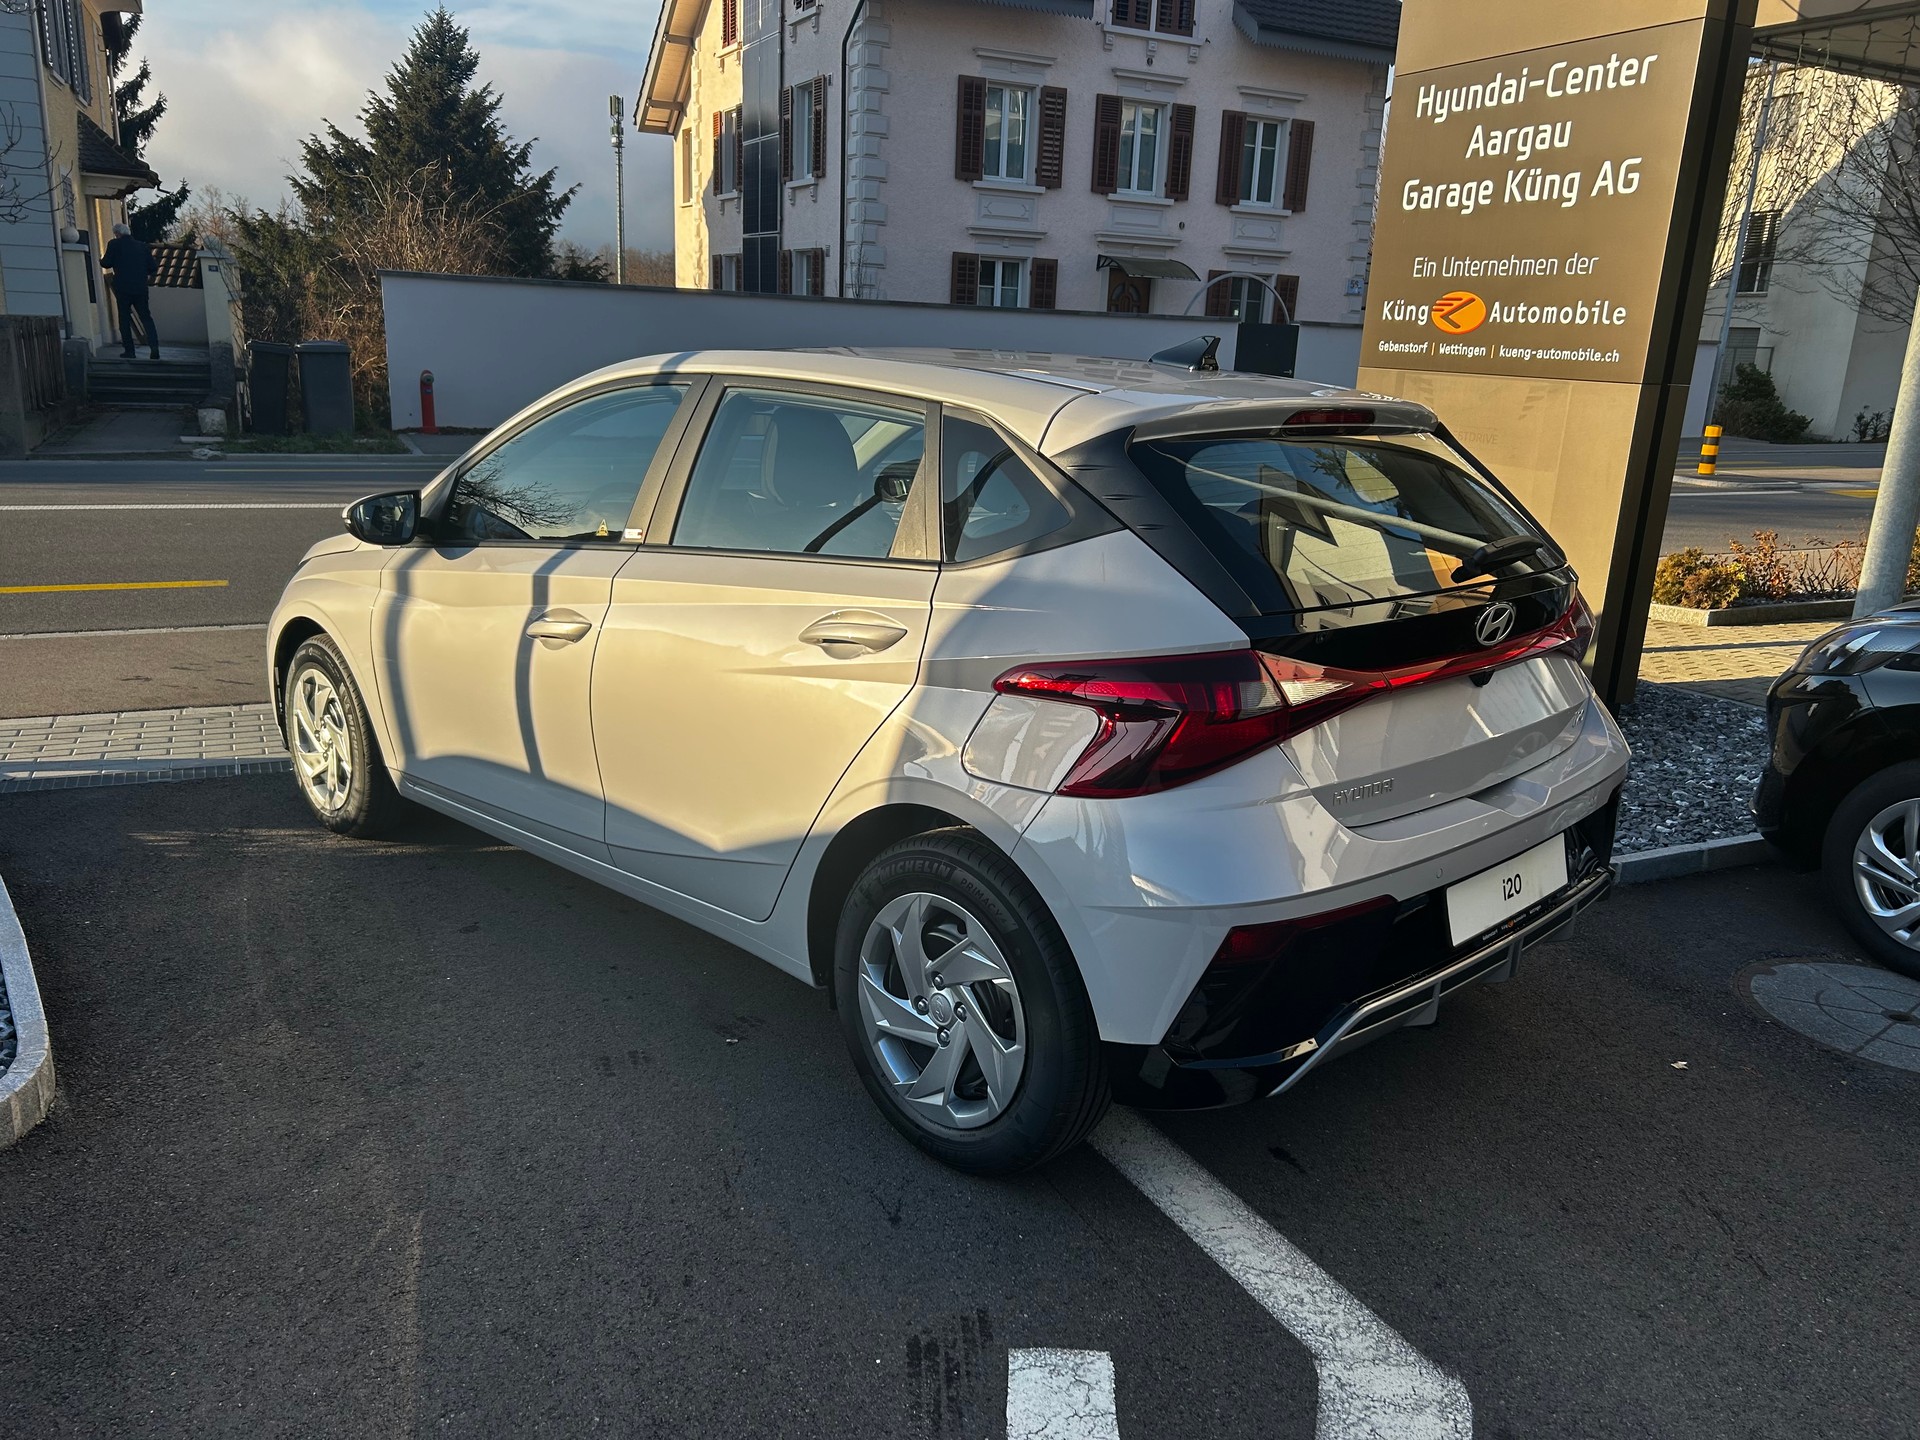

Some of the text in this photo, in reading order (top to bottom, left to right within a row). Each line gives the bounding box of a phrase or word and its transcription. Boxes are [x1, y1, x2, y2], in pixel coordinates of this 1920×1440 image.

[1416, 53, 1659, 123] Hyundai-Center
[1465, 120, 1572, 162] Aargau
[1402, 157, 1643, 215] Garage Küng AG
[1412, 252, 1600, 278] Ein Unternehmen der
[1382, 299, 1627, 326] Küng Automobile
[1378, 340, 1429, 354] Gebenstorf
[1439, 342, 1486, 357] Wettingen
[1499, 344, 1620, 363] kueng-automobile.ch
[1332, 777, 1395, 807] HYUNDAI
[877, 859, 951, 882] MICHELIN
[960, 877, 1003, 917] PRIMACY
[1502, 873, 1522, 901] i20
